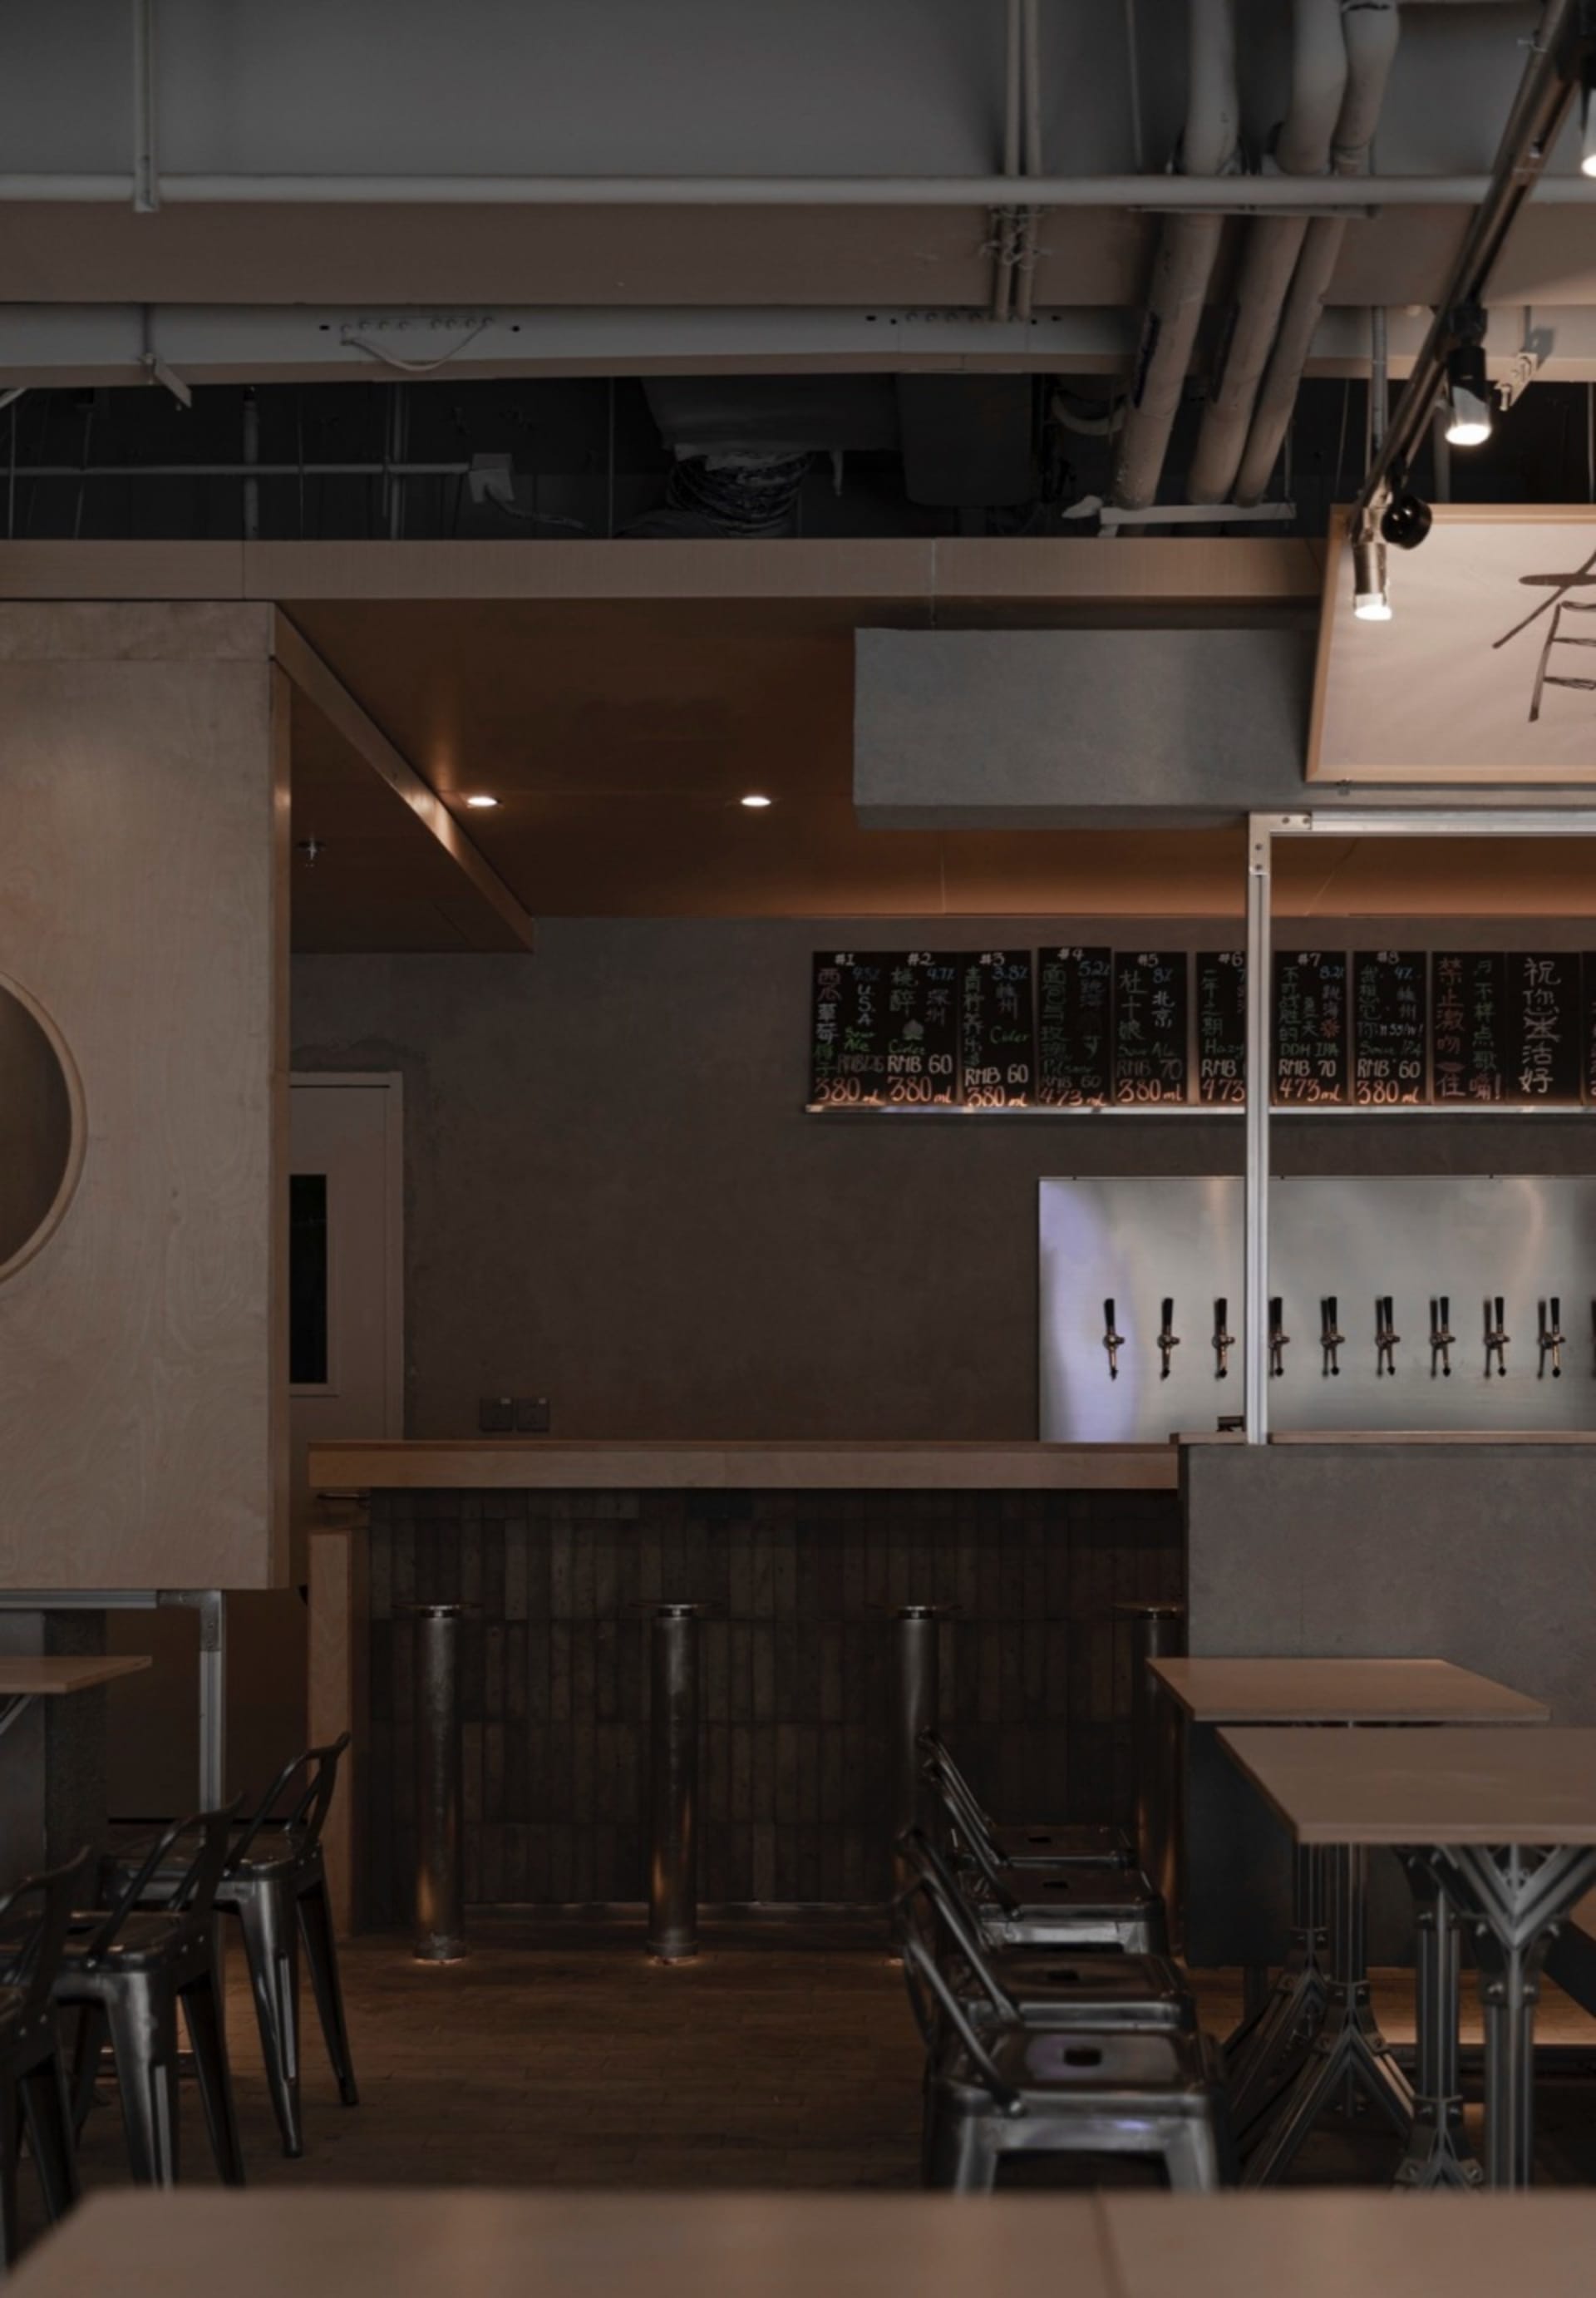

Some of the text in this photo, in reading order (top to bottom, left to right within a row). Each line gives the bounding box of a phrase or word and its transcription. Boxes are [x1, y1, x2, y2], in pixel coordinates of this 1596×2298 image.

[835, 953, 856, 966] #1
[908, 952, 936, 966] #2
[979, 952, 1005, 966] #3
[1057, 948, 1085, 962] #4
[1137, 954, 1160, 969] #5
[1218, 952, 1244, 968] #6
[1297, 953, 1323, 967] #7
[1377, 952, 1401, 965] #8
[1150, 990, 1176, 1028] 北京
[887, 1053, 953, 1074] RMB 60
[1116, 1058, 1184, 1081] RMB 70
[1201, 1058, 1239, 1078] RMB
[1278, 1058, 1337, 1077] RMB 70
[1356, 1058, 1422, 1079] RMB 60
[965, 1063, 1030, 1087] RMB 60
[1081, 1075, 1103, 1089] 60
